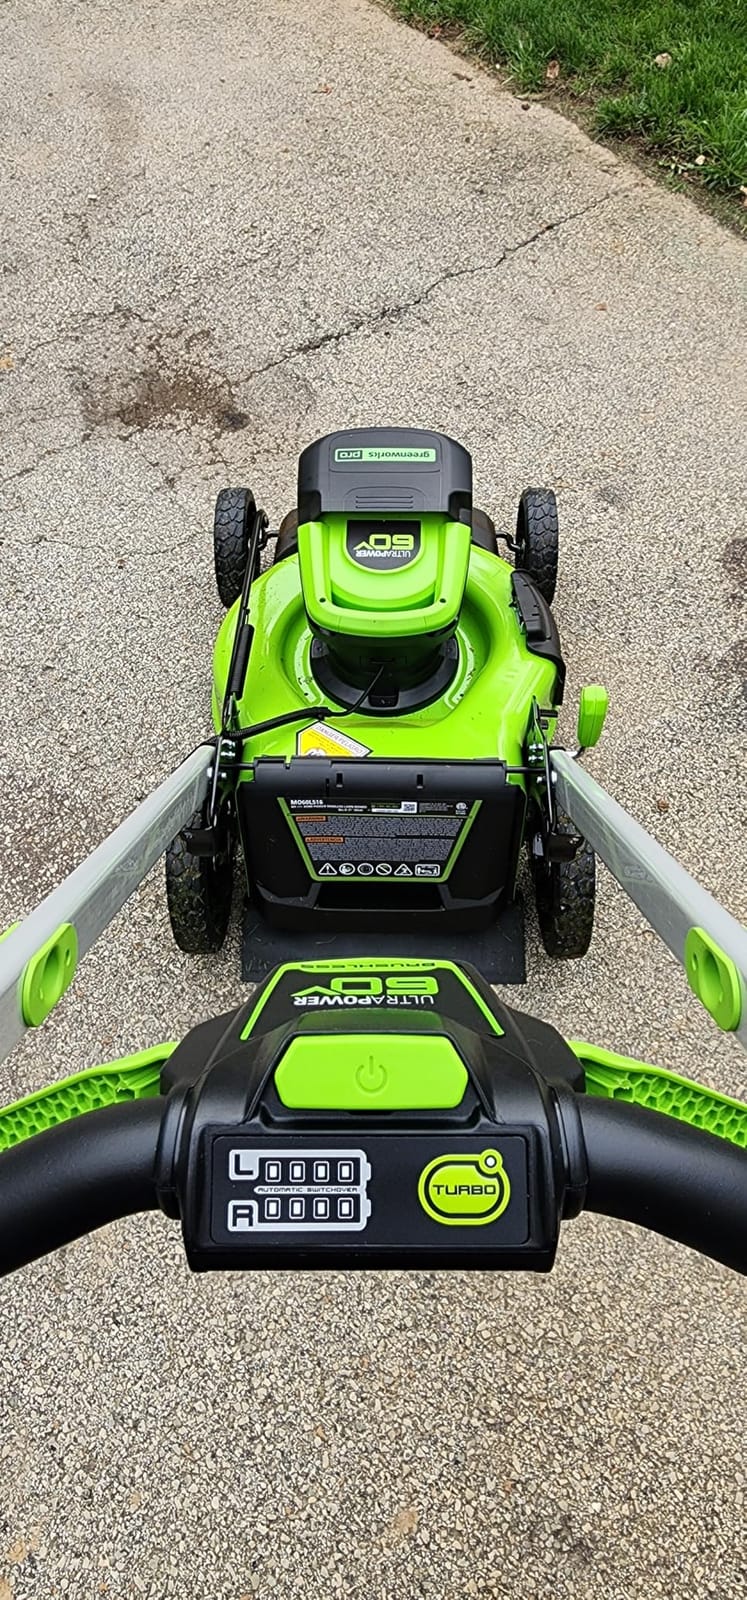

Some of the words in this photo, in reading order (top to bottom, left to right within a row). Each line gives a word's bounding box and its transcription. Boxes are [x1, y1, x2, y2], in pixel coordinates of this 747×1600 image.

[339, 450, 361, 459] pro
[368, 450, 430, 460] greenworks
[353, 533, 414, 551] 60V
[355, 550, 411, 558] ULTRAPOWER
[300, 961, 435, 969] BRUSHLESS
[290, 976, 439, 997] 60V
[293, 995, 435, 1006] ULTRAPOWER
[234, 1154, 254, 1175] L
[432, 1184, 496, 1196] TURBO
[232, 1205, 254, 1227] R
